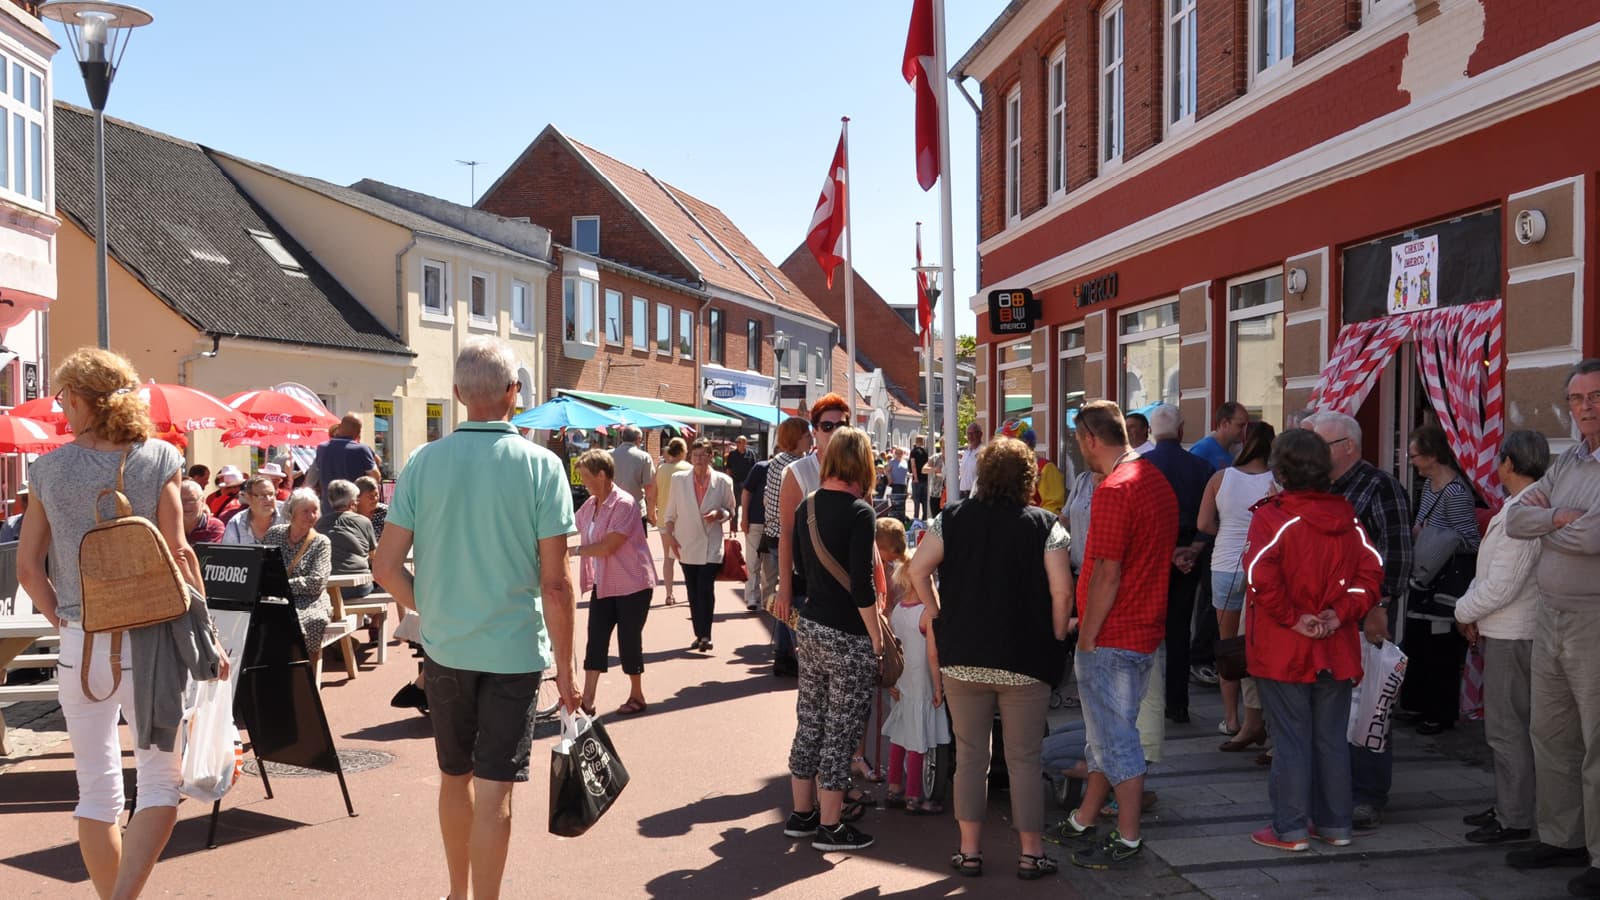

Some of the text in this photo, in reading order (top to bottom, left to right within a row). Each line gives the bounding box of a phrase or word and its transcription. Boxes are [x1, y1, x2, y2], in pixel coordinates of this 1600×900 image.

[1404, 241, 1425, 255] CIRKUS
[204, 564, 248, 584] TUBORG
[584, 742, 596, 757] SB
